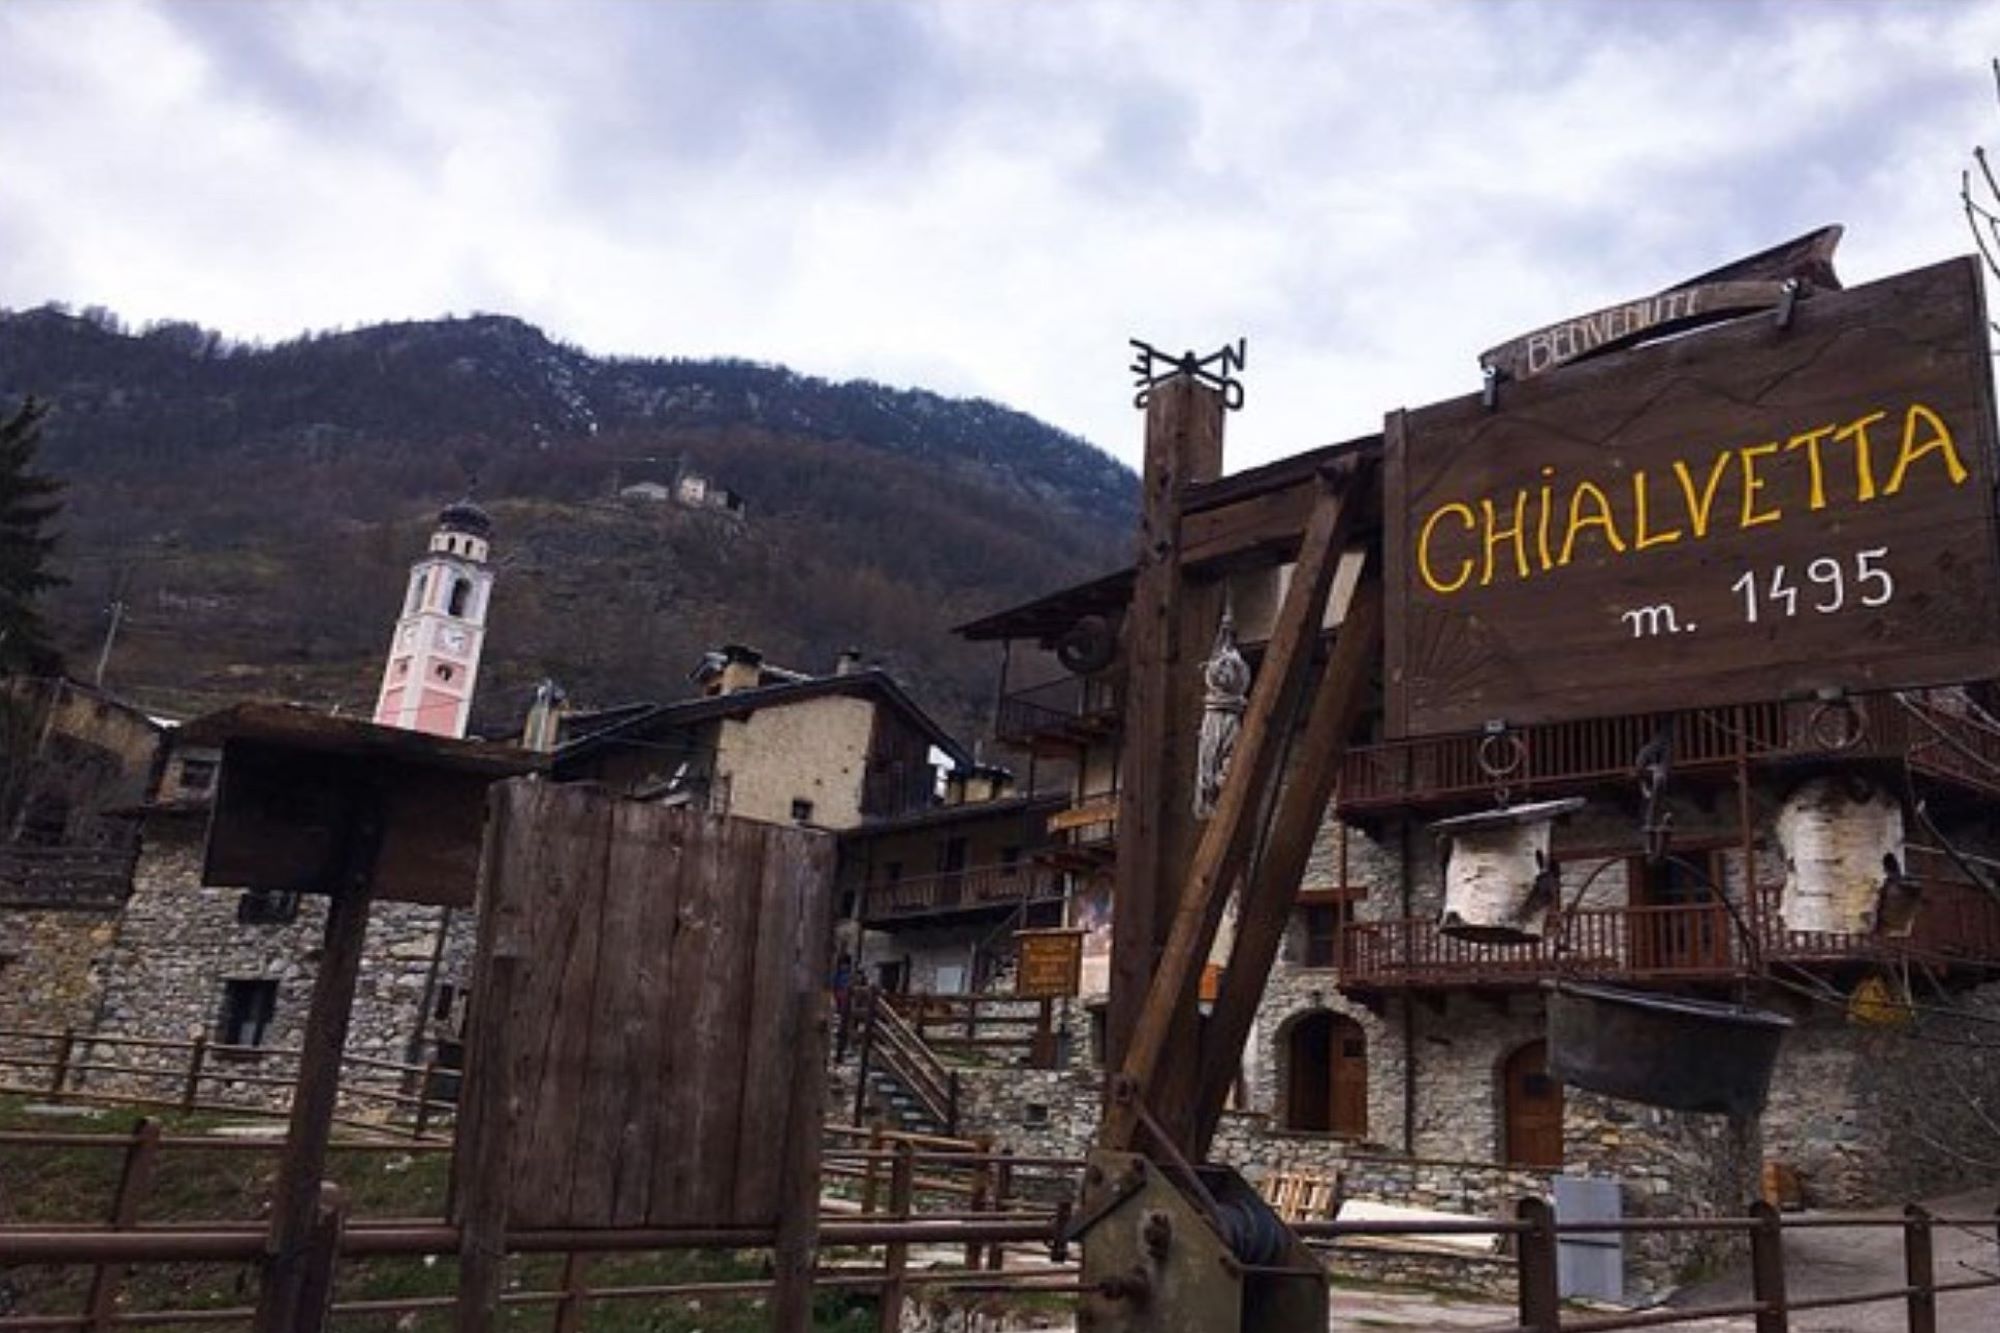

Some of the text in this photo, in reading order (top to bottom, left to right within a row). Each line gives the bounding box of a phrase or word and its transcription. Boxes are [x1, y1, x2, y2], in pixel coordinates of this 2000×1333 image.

[1527, 289, 1699, 373] BENVENUTI
[1417, 403, 1968, 592] CHIALVETTA
[1621, 546, 1893, 638] m. 1495
